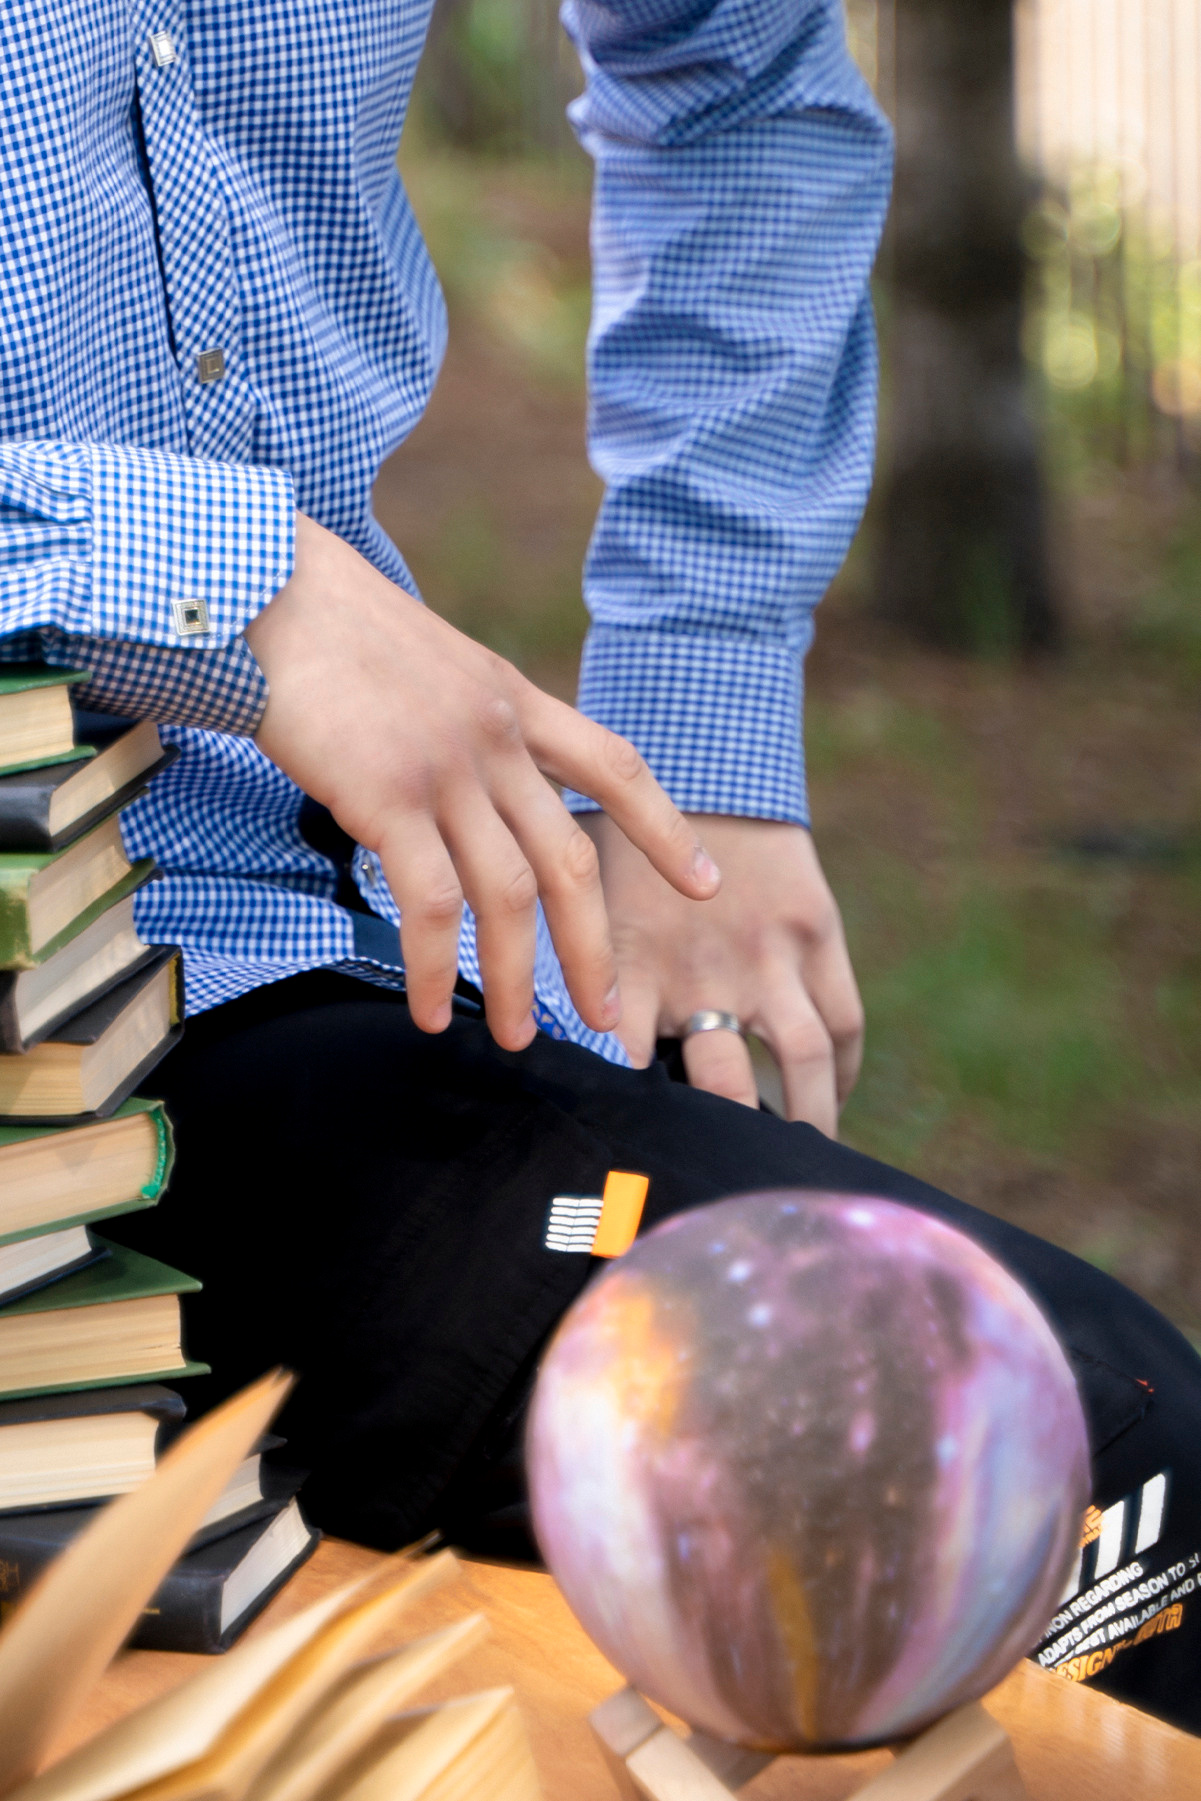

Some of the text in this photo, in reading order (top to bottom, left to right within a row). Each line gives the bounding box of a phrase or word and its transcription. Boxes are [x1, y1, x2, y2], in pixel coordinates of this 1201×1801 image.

[1037, 1626, 1083, 1667] ADAPTS
[1080, 1602, 1116, 1635] FROM
[1114, 1572, 1169, 1612] SEASON
[1168, 1562, 1186, 1581] TO
[1069, 1561, 1144, 1617] REGARDING
[1108, 1595, 1169, 1641] AVAILABLE
[1170, 1579, 1195, 1601] AND
